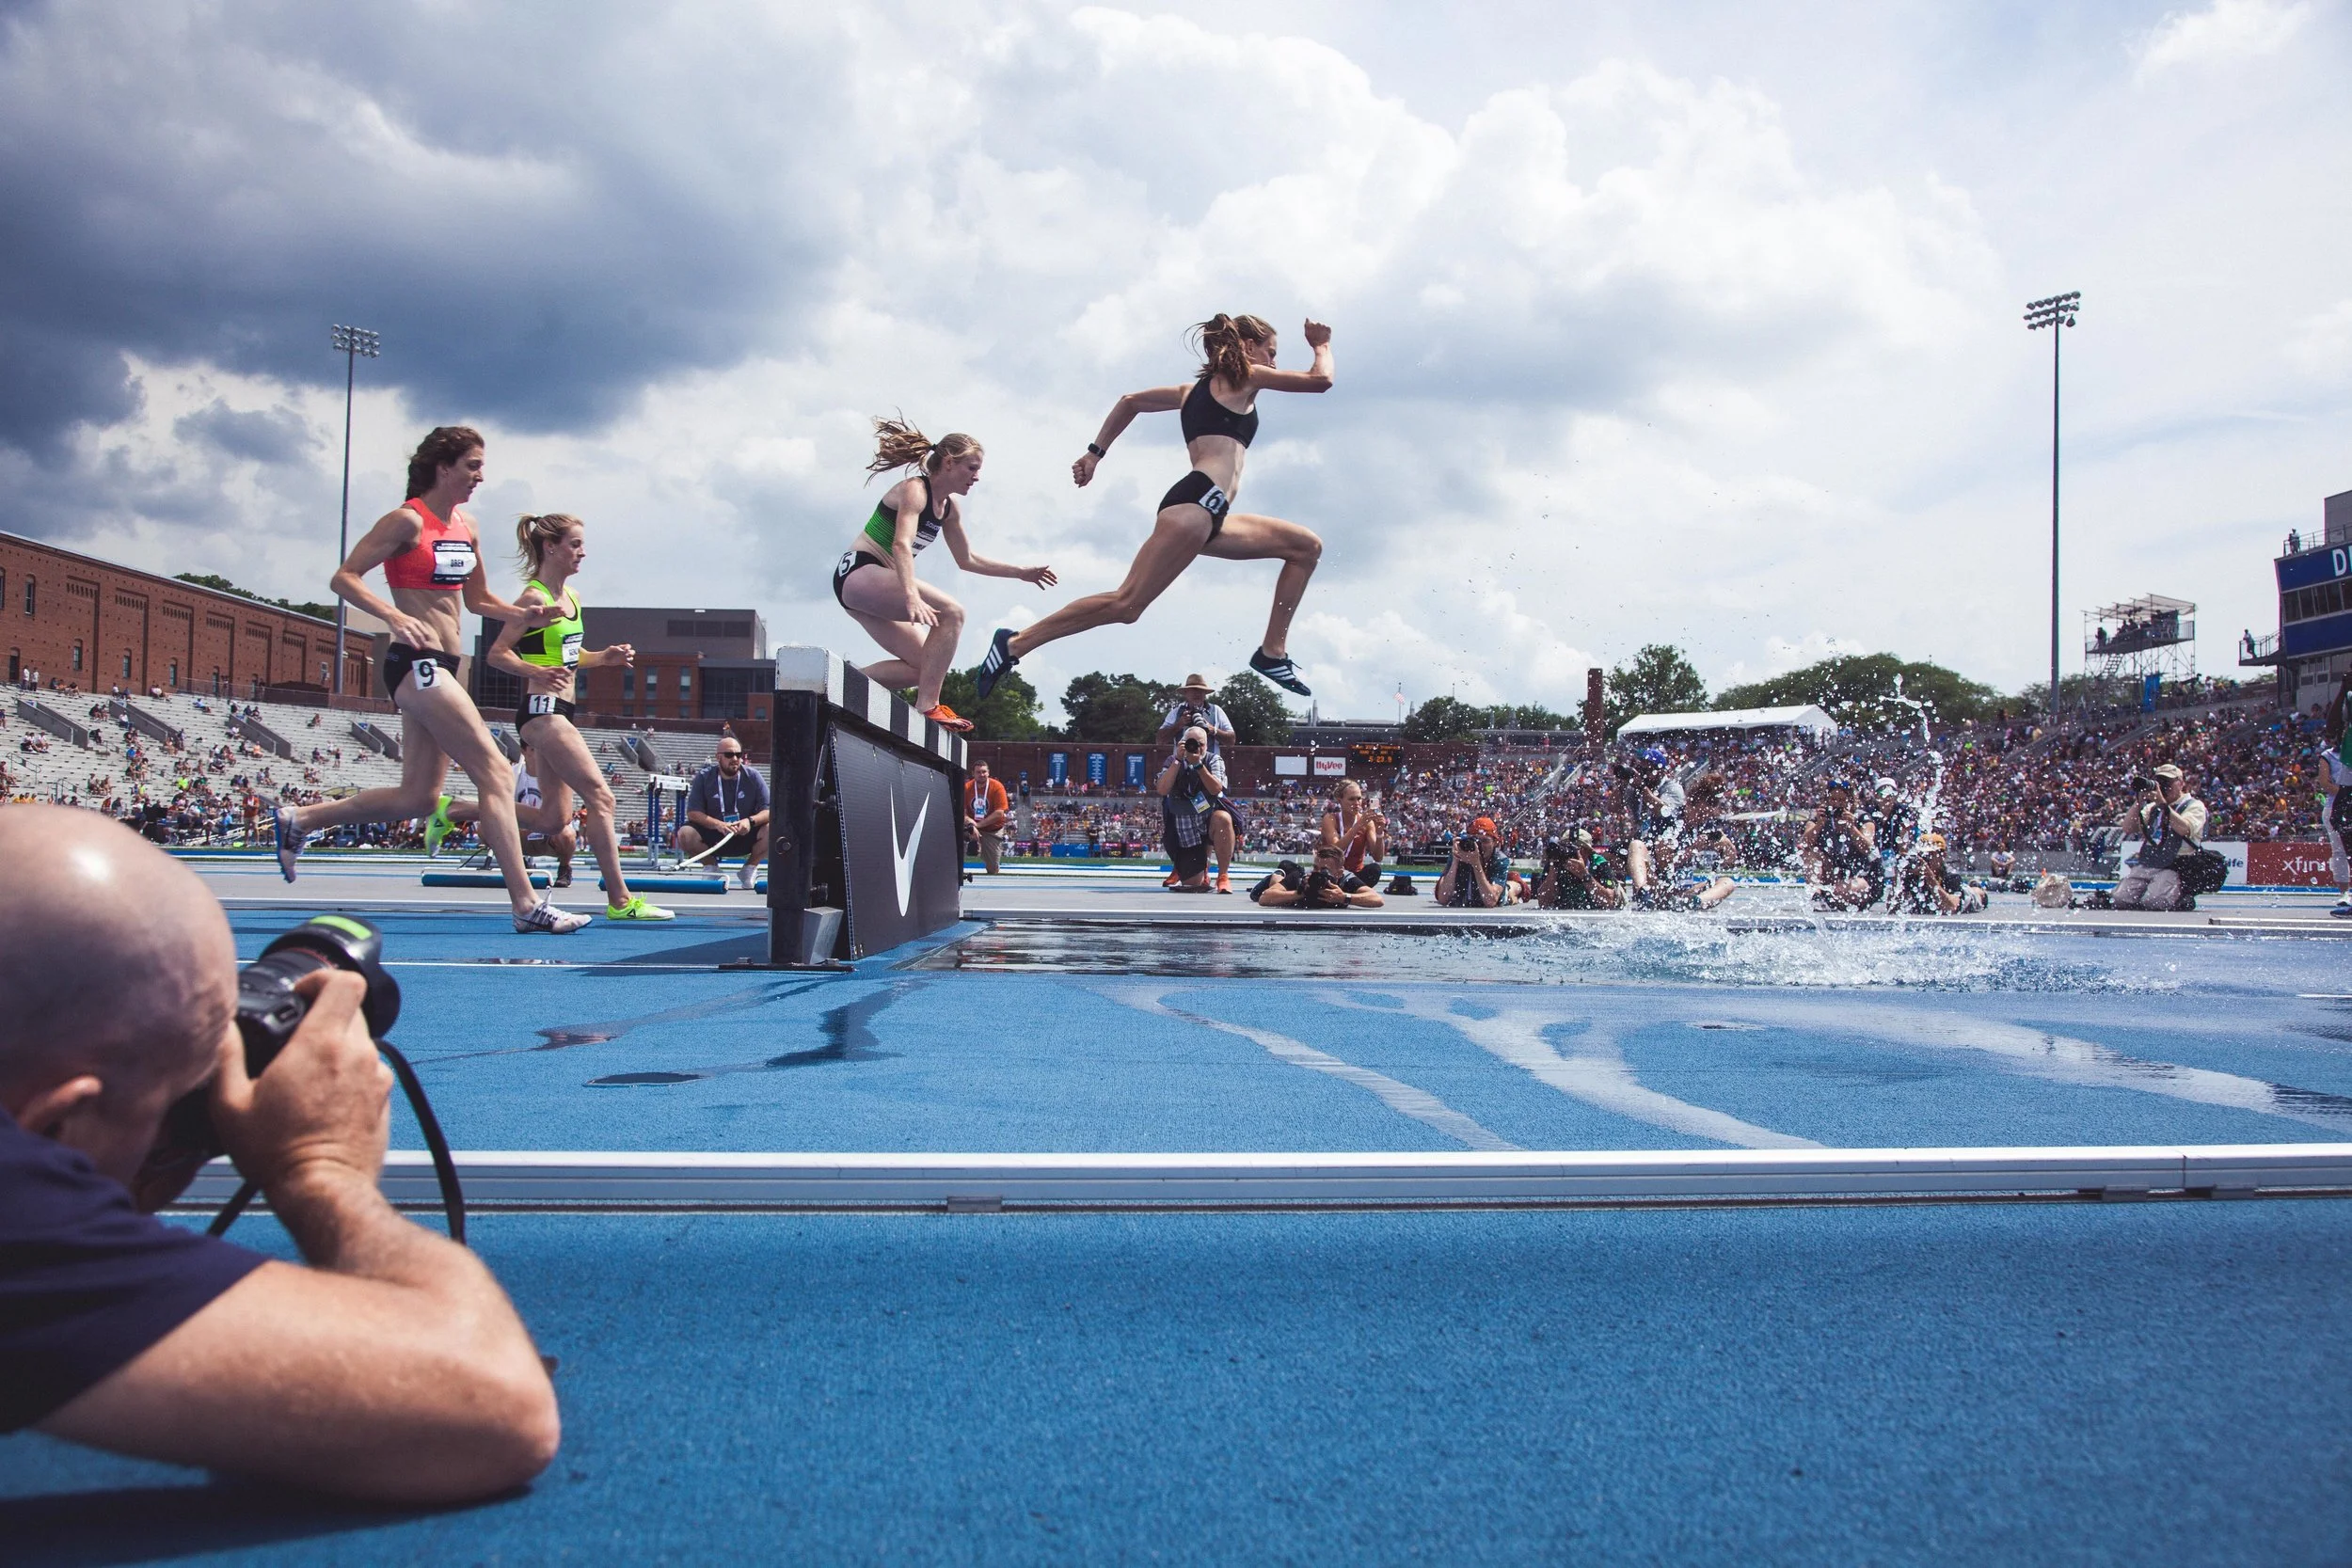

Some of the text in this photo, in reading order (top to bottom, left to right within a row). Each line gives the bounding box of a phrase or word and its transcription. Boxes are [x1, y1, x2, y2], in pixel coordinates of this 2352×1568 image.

[1205, 489, 1222, 510] 6
[841, 552, 852, 574] 5
[420, 660, 435, 688] 9
[533, 696, 550, 713] 11
